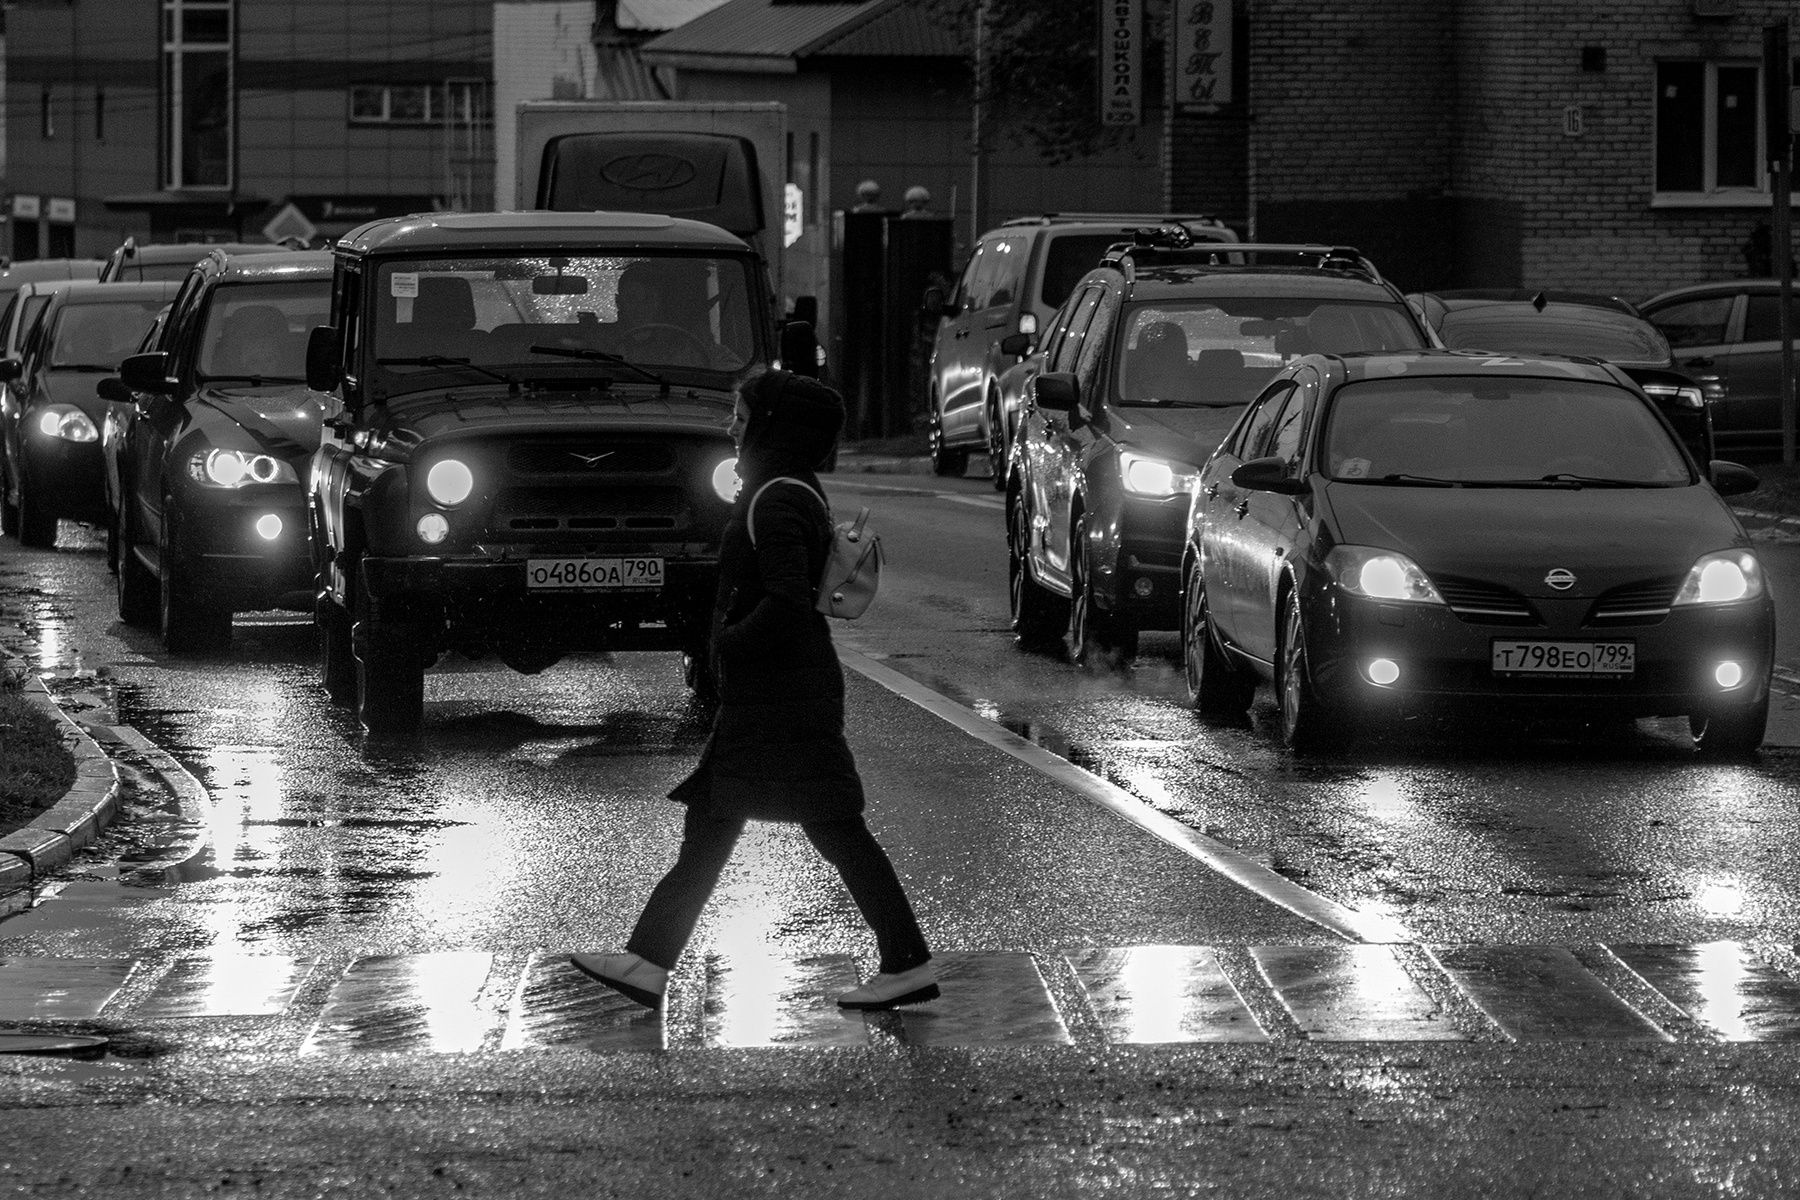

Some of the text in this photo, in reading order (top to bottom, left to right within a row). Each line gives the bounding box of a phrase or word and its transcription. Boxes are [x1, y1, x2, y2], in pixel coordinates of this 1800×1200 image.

[1567, 109, 1579, 132] 16
[533, 560, 658, 584] О486ОА 790
[1501, 645, 1629, 669] Т798ЕО 799
